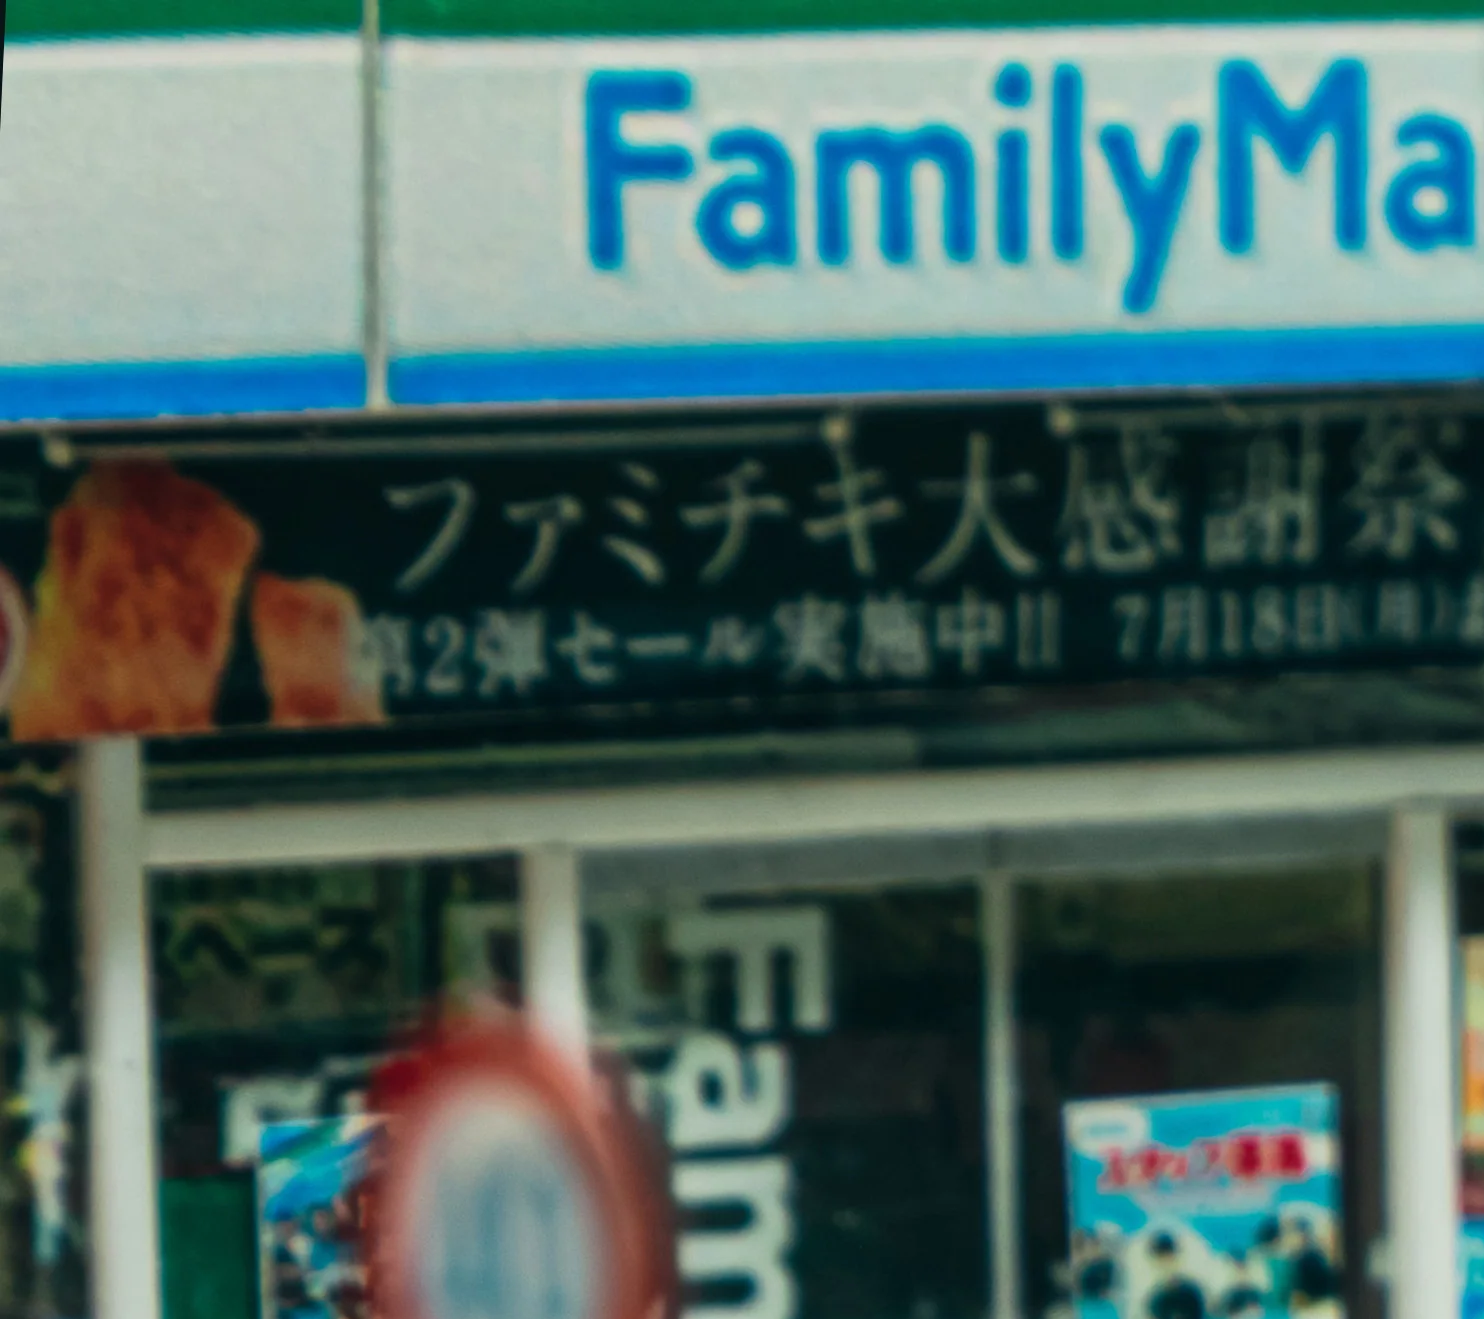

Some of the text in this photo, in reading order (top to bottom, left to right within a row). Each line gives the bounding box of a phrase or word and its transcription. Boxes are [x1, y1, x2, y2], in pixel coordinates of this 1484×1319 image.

[384, 408, 1466, 592] ファミチキ大感謝祭
